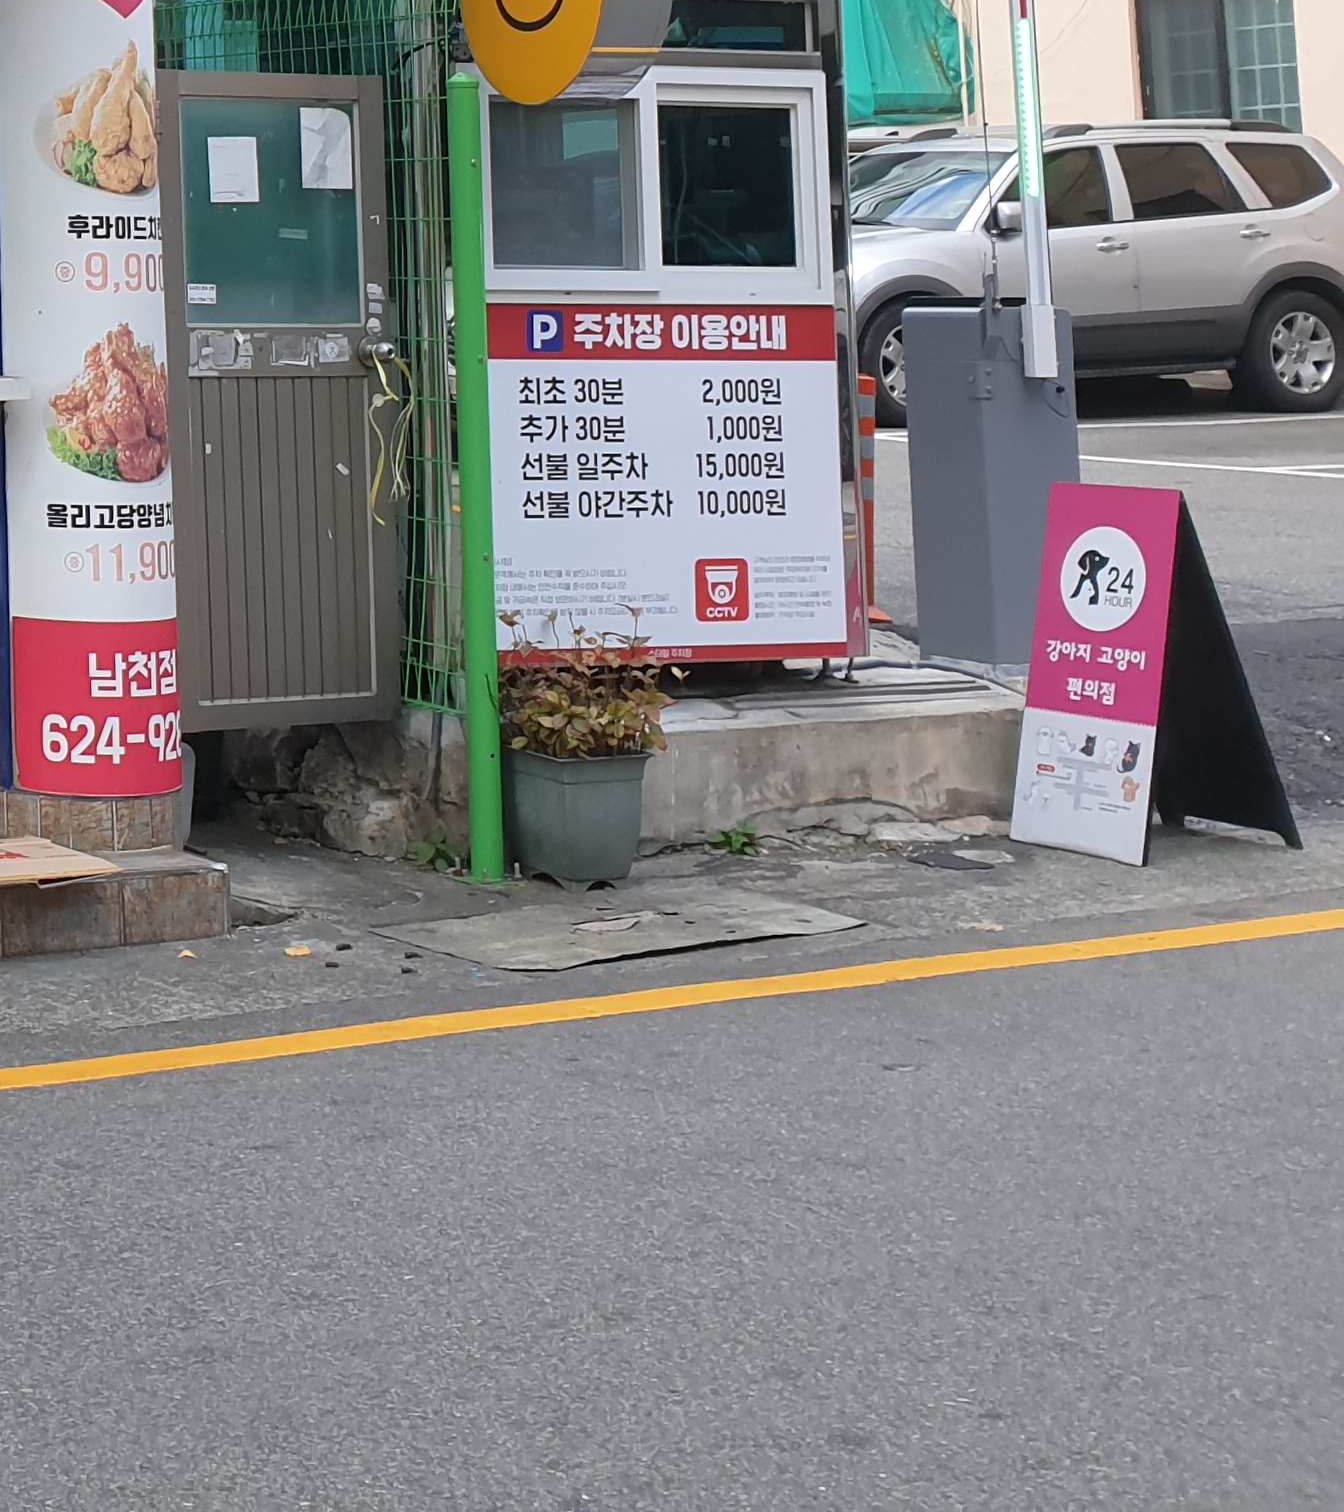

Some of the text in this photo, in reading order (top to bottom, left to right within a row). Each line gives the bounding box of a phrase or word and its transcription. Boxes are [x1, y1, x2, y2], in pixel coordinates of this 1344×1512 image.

[532, 313, 787, 351] P 주차장 이용안내
[518, 377, 782, 406] 최초 30분 2,000원
[519, 414, 784, 443] 추가 30분 1,000원
[521, 452, 785, 481] 선불 일주차 15,000원
[522, 489, 787, 519] 선불 야간주차 10,000원
[1106, 566, 1134, 594] 24
[706, 606, 738, 618] CCTV
[1104, 595, 1133, 608] HOUR
[1046, 640, 1146, 670] 강아지 고양이
[89, 649, 176, 697] 남천점
[1066, 678, 1116, 705] 편의점
